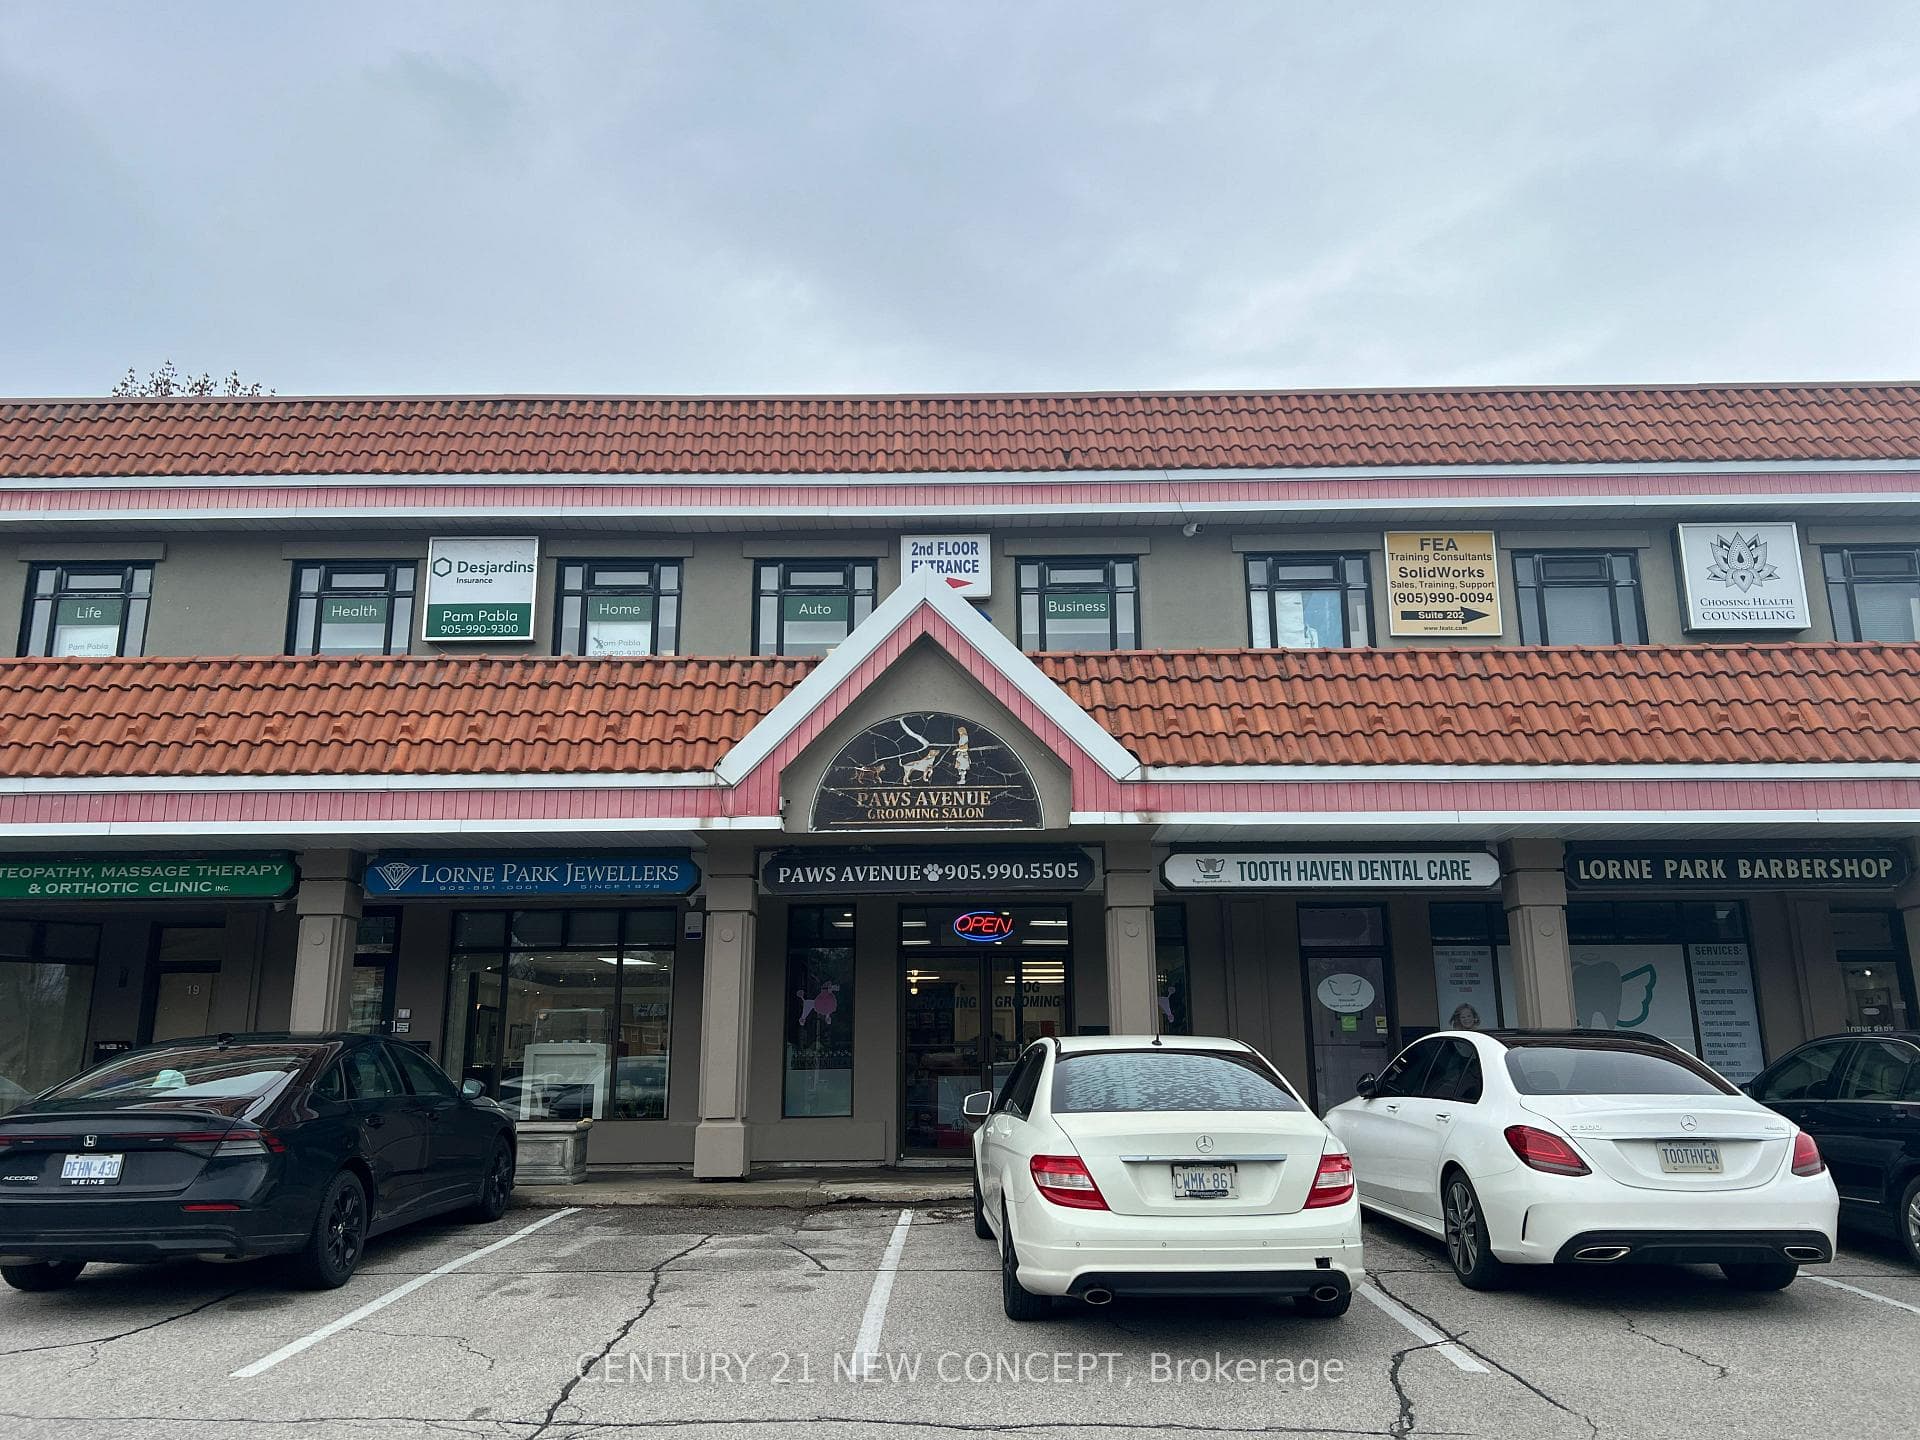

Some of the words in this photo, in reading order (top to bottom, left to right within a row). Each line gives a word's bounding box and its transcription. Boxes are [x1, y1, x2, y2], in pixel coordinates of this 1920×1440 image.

[911, 541, 934, 556] 2nd
[937, 541, 979, 556] FLOOR
[1419, 538, 1459, 551] FEA
[1389, 552, 1430, 563] Training
[1433, 552, 1492, 562] Consultants
[457, 559, 535, 577] Desjardins
[911, 559, 980, 574] ETRANCE
[1398, 566, 1485, 578] SolidWorks
[456, 576, 493, 584] Insurance
[1390, 580, 1418, 590] Sales,
[1418, 580, 1458, 591] Training,
[1459, 580, 1495, 591] Support
[1393, 592, 1494, 606] (905)990-0094
[76, 606, 102, 619] Life
[331, 604, 378, 617] Health
[599, 603, 641, 615] Home
[799, 603, 832, 615] Auto
[1048, 600, 1106, 613] Business
[443, 610, 475, 623] Pam
[478, 610, 518, 623] Pabla
[1418, 611, 1444, 619] Suite
[1446, 611, 1465, 619] 202
[1702, 610, 1796, 621] COUNSELLING
[440, 624, 519, 635] 905-990-9300
[618, 639, 641, 647] Pabla
[856, 791, 911, 807] PAWS
[915, 790, 991, 806] AVENUE
[867, 807, 939, 820] GROOMING
[942, 807, 985, 818] SALON
[101, 865, 190, 879] MASSAGE
[197, 864, 284, 877] THERAPY
[420, 863, 495, 884] LORNE
[501, 863, 559, 883] PARK
[563, 862, 679, 886] JEWELLERS
[778, 866, 836, 884] PAWS
[840, 865, 921, 882] AVENUE
[944, 862, 1080, 881] 905.990.5505
[1236, 860, 1293, 882] TOOTH
[1296, 860, 1354, 881] HAVEN
[1358, 860, 1423, 881] DENTAL
[1427, 859, 1472, 881] CARE
[1578, 859, 1653, 880] LORNE
[1664, 858, 1728, 880] PARK
[1737, 858, 1894, 879] BARBERSHOP
[28, 883, 41, 894] &
[45, 882, 140, 894] ORTHOTIC
[148, 881, 213, 894] CLINIC
[956, 914, 1013, 933] OPEN
[186, 984, 200, 995] 19
[1661, 1148, 1720, 1165] TOOTHVEN
[63, 1161, 93, 1177] DFHN
[98, 1161, 120, 1177] 430
[1175, 1173, 1206, 1189] CWMK
[1212, 1172, 1235, 1189] 861
